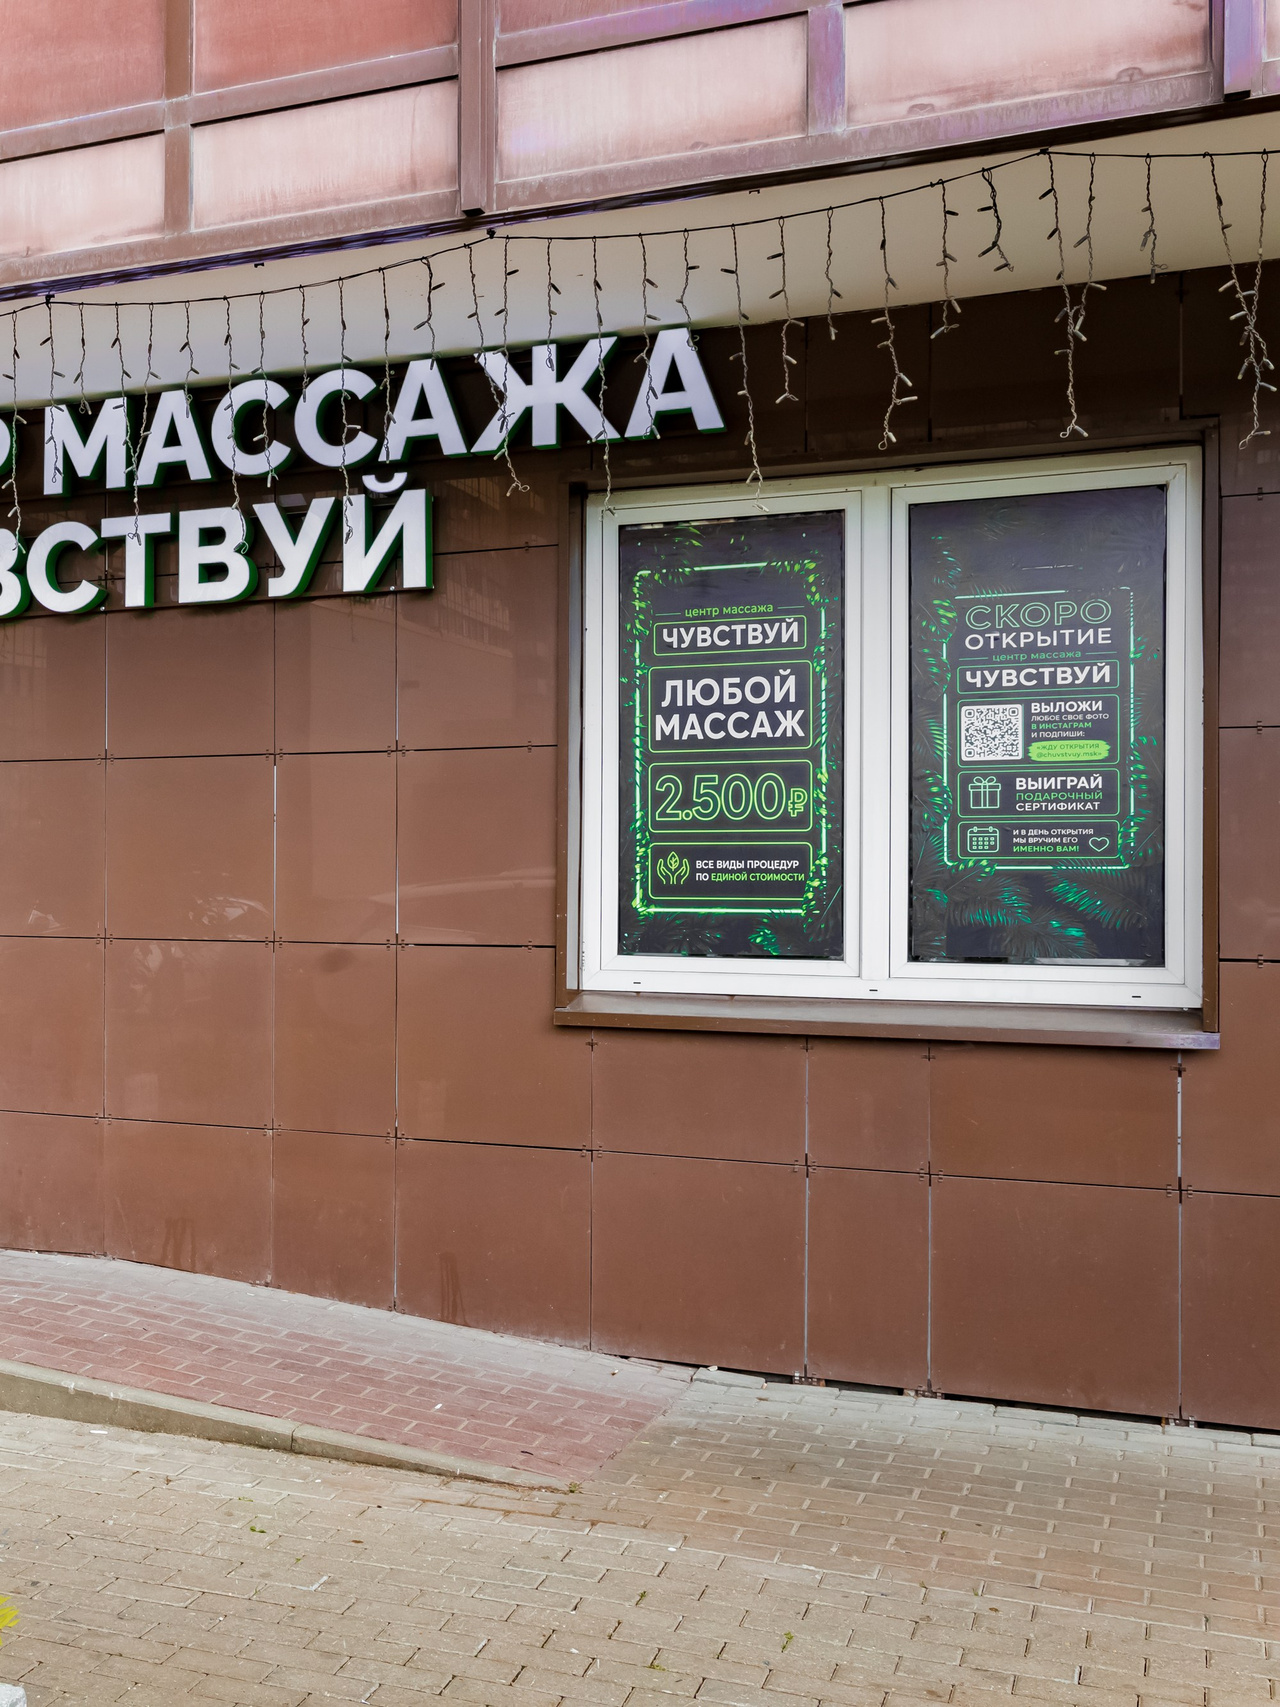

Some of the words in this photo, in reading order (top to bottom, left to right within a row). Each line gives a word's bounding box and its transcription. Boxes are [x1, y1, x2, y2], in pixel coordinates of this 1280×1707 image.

[43, 328, 727, 495] МАССАЖА
[685, 608, 720, 618] центр
[723, 603, 774, 614] массажа
[965, 599, 1112, 630] СКОРО
[662, 618, 799, 649] ЧУВСТВУЙ
[964, 628, 1112, 650] ОТКРЫТИЕ
[992, 653, 1027, 662] центр
[1030, 650, 1082, 660] массажа
[965, 662, 1111, 688] ЧУВСТВУЙ
[661, 668, 796, 708] ЛЮБОЙ
[1031, 700, 1103, 713] ВЫЛОЖИ
[1030, 714, 1061, 722] ЛЮБОЕ
[1085, 713, 1110, 721] ФОТО
[655, 709, 805, 741] МАССАЖ
[1039, 722, 1092, 730] ИНСТАГРАМ
[1039, 730, 1086, 739] ПОДПИШИ:
[1015, 774, 1103, 790] ВЫИГРАЙ
[1015, 790, 1103, 802] ПОДАРОЧНЫЙ
[1015, 802, 1100, 811] СЕРТИФИКАТ
[695, 860, 715, 869] ВСЕ
[716, 860, 745, 870] ВИДЫ
[746, 860, 800, 871] ПРОЦЕДУР
[695, 873, 709, 881] ПО
[711, 871, 748, 882] ЕДИНОЙ
[749, 873, 805, 882] СТОИМОСТИ
